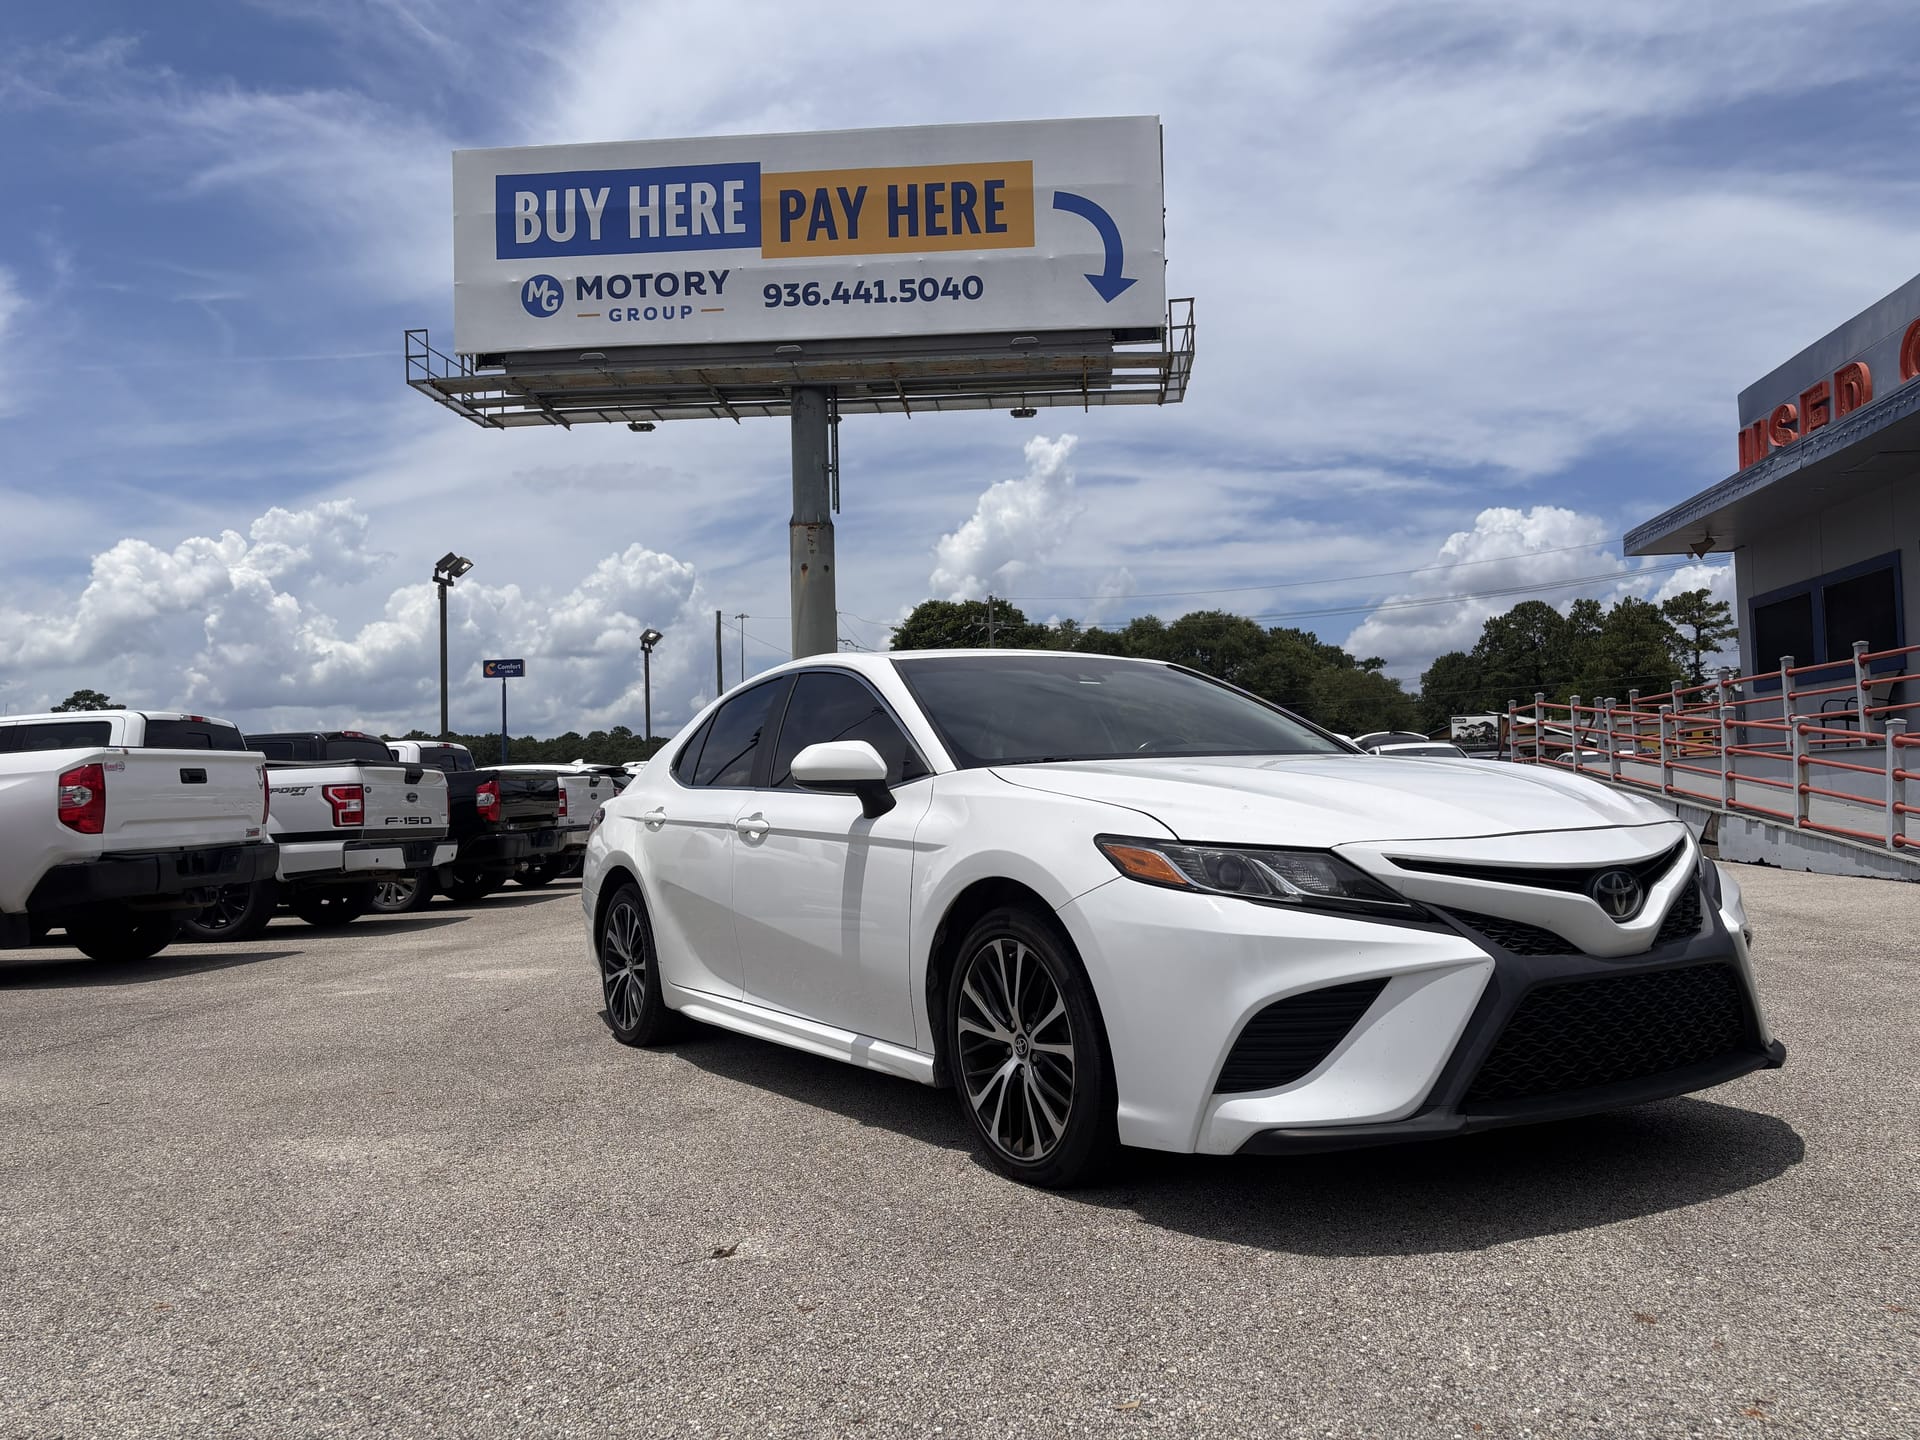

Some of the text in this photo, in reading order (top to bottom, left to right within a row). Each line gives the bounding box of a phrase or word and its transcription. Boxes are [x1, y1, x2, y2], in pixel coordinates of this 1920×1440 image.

[514, 179, 746, 244] BUY HERE
[778, 178, 1008, 243] PAY HERE
[526, 279, 563, 313] MG
[575, 269, 730, 301] MOTORY
[762, 274, 984, 309] 936.441.5040
[608, 305, 693, 323] GROUP
[497, 663, 521, 671] Comfort
[269, 786, 314, 794] PORT
[385, 816, 432, 825] F-150
